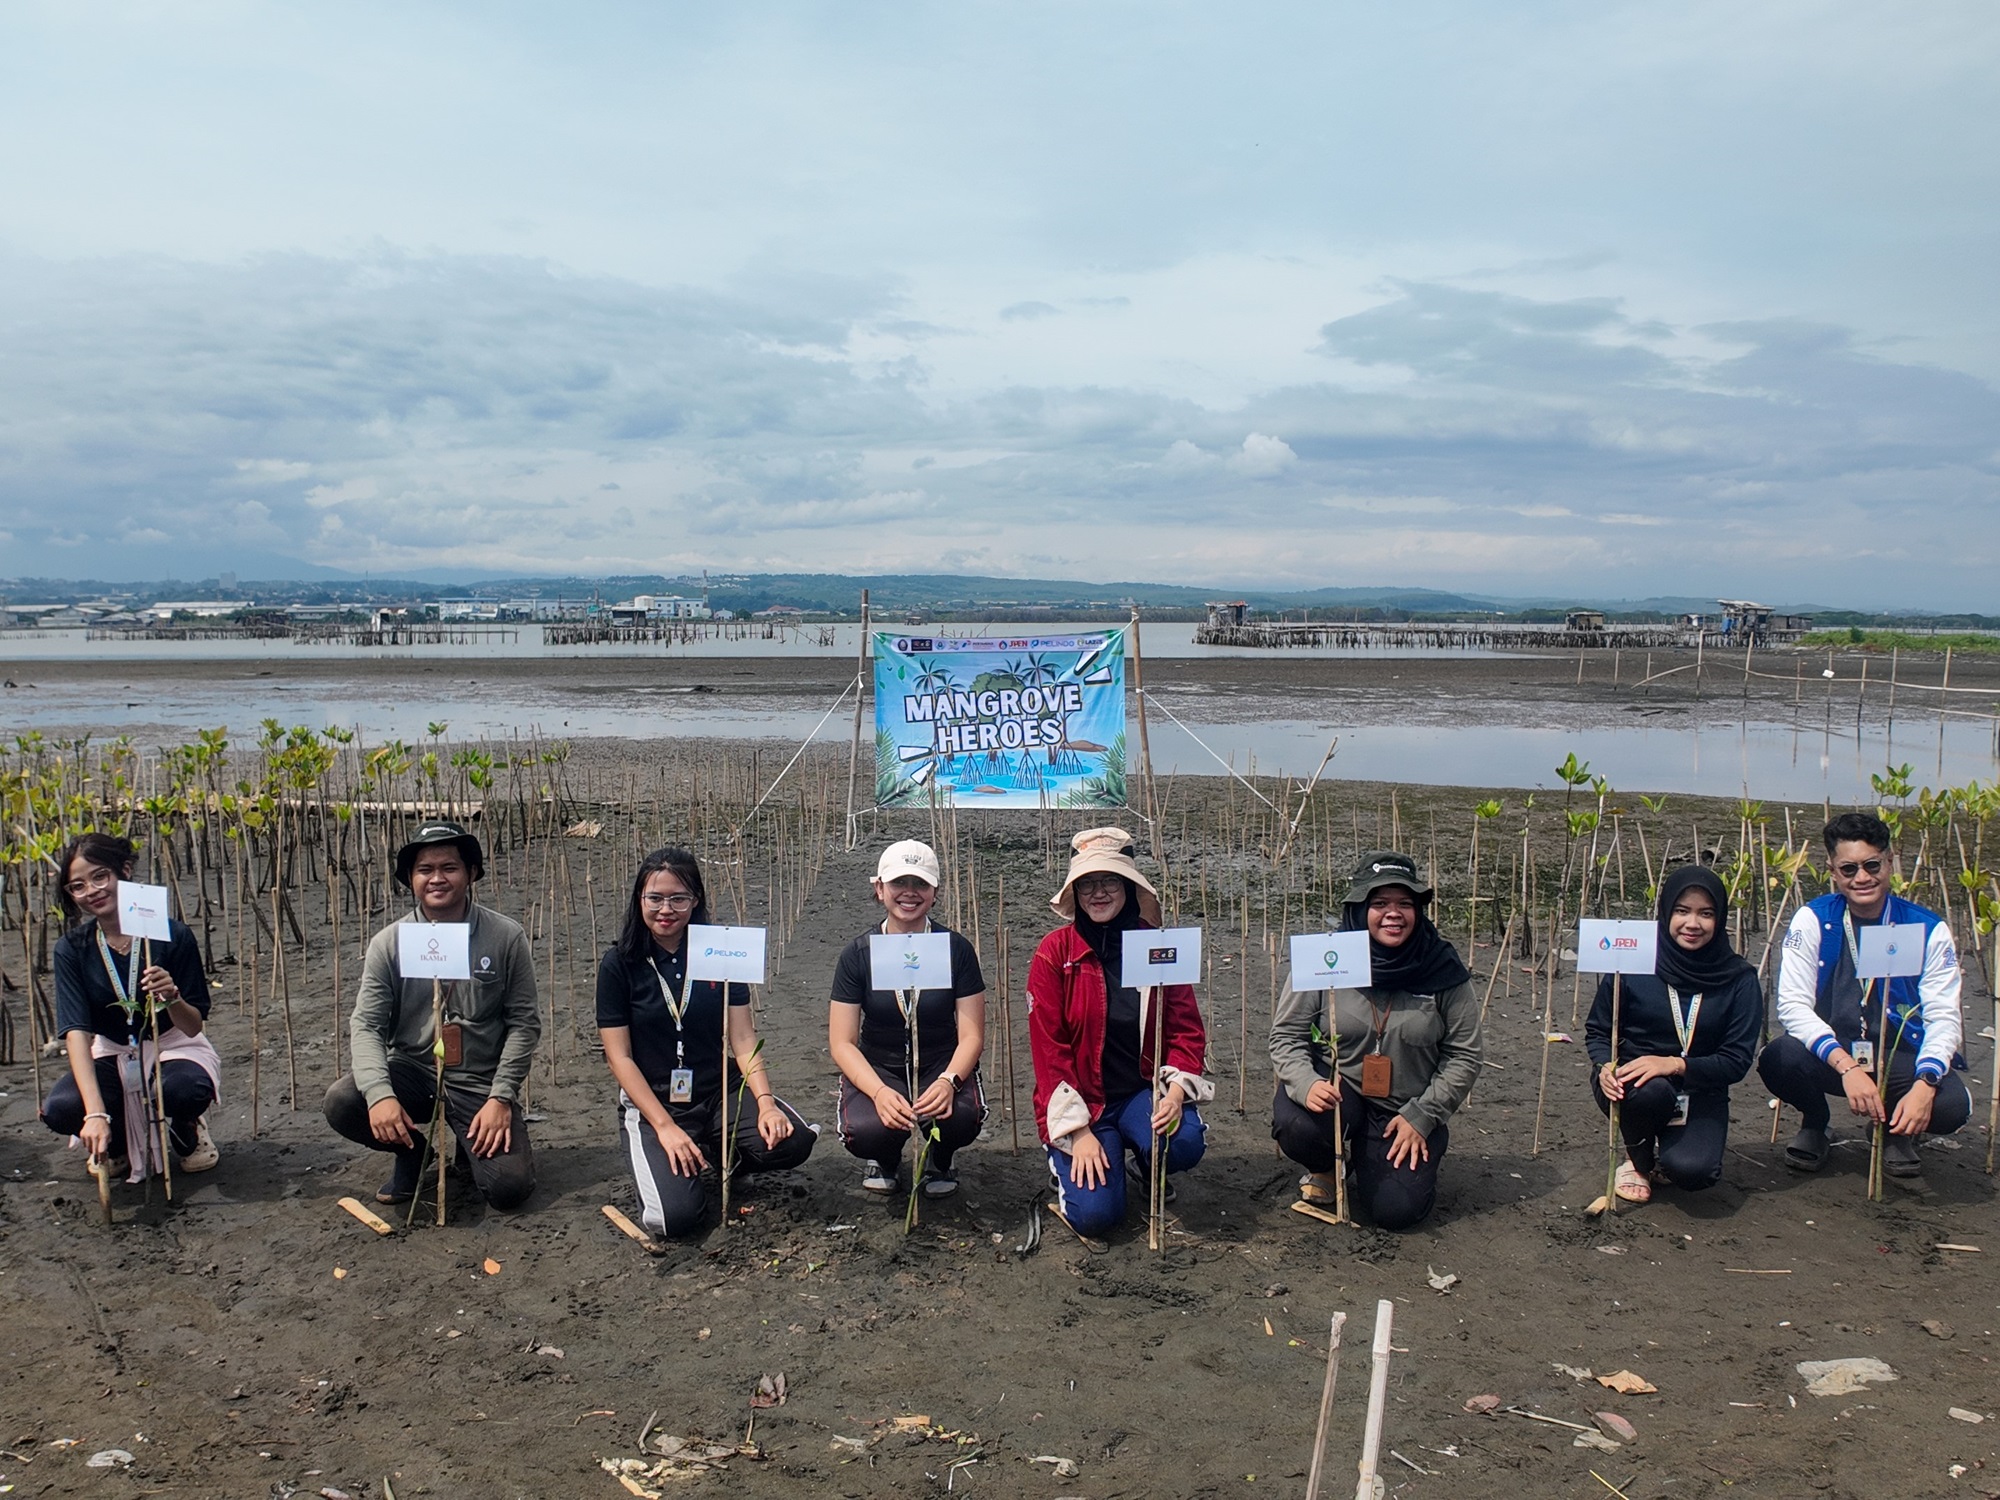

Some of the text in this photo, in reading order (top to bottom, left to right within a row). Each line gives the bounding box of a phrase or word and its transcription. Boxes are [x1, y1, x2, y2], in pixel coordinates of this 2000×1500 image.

[904, 684, 1082, 723] MANGROVE
[936, 718, 1062, 754] HEROES
[1612, 937, 1637, 948] JPEN
